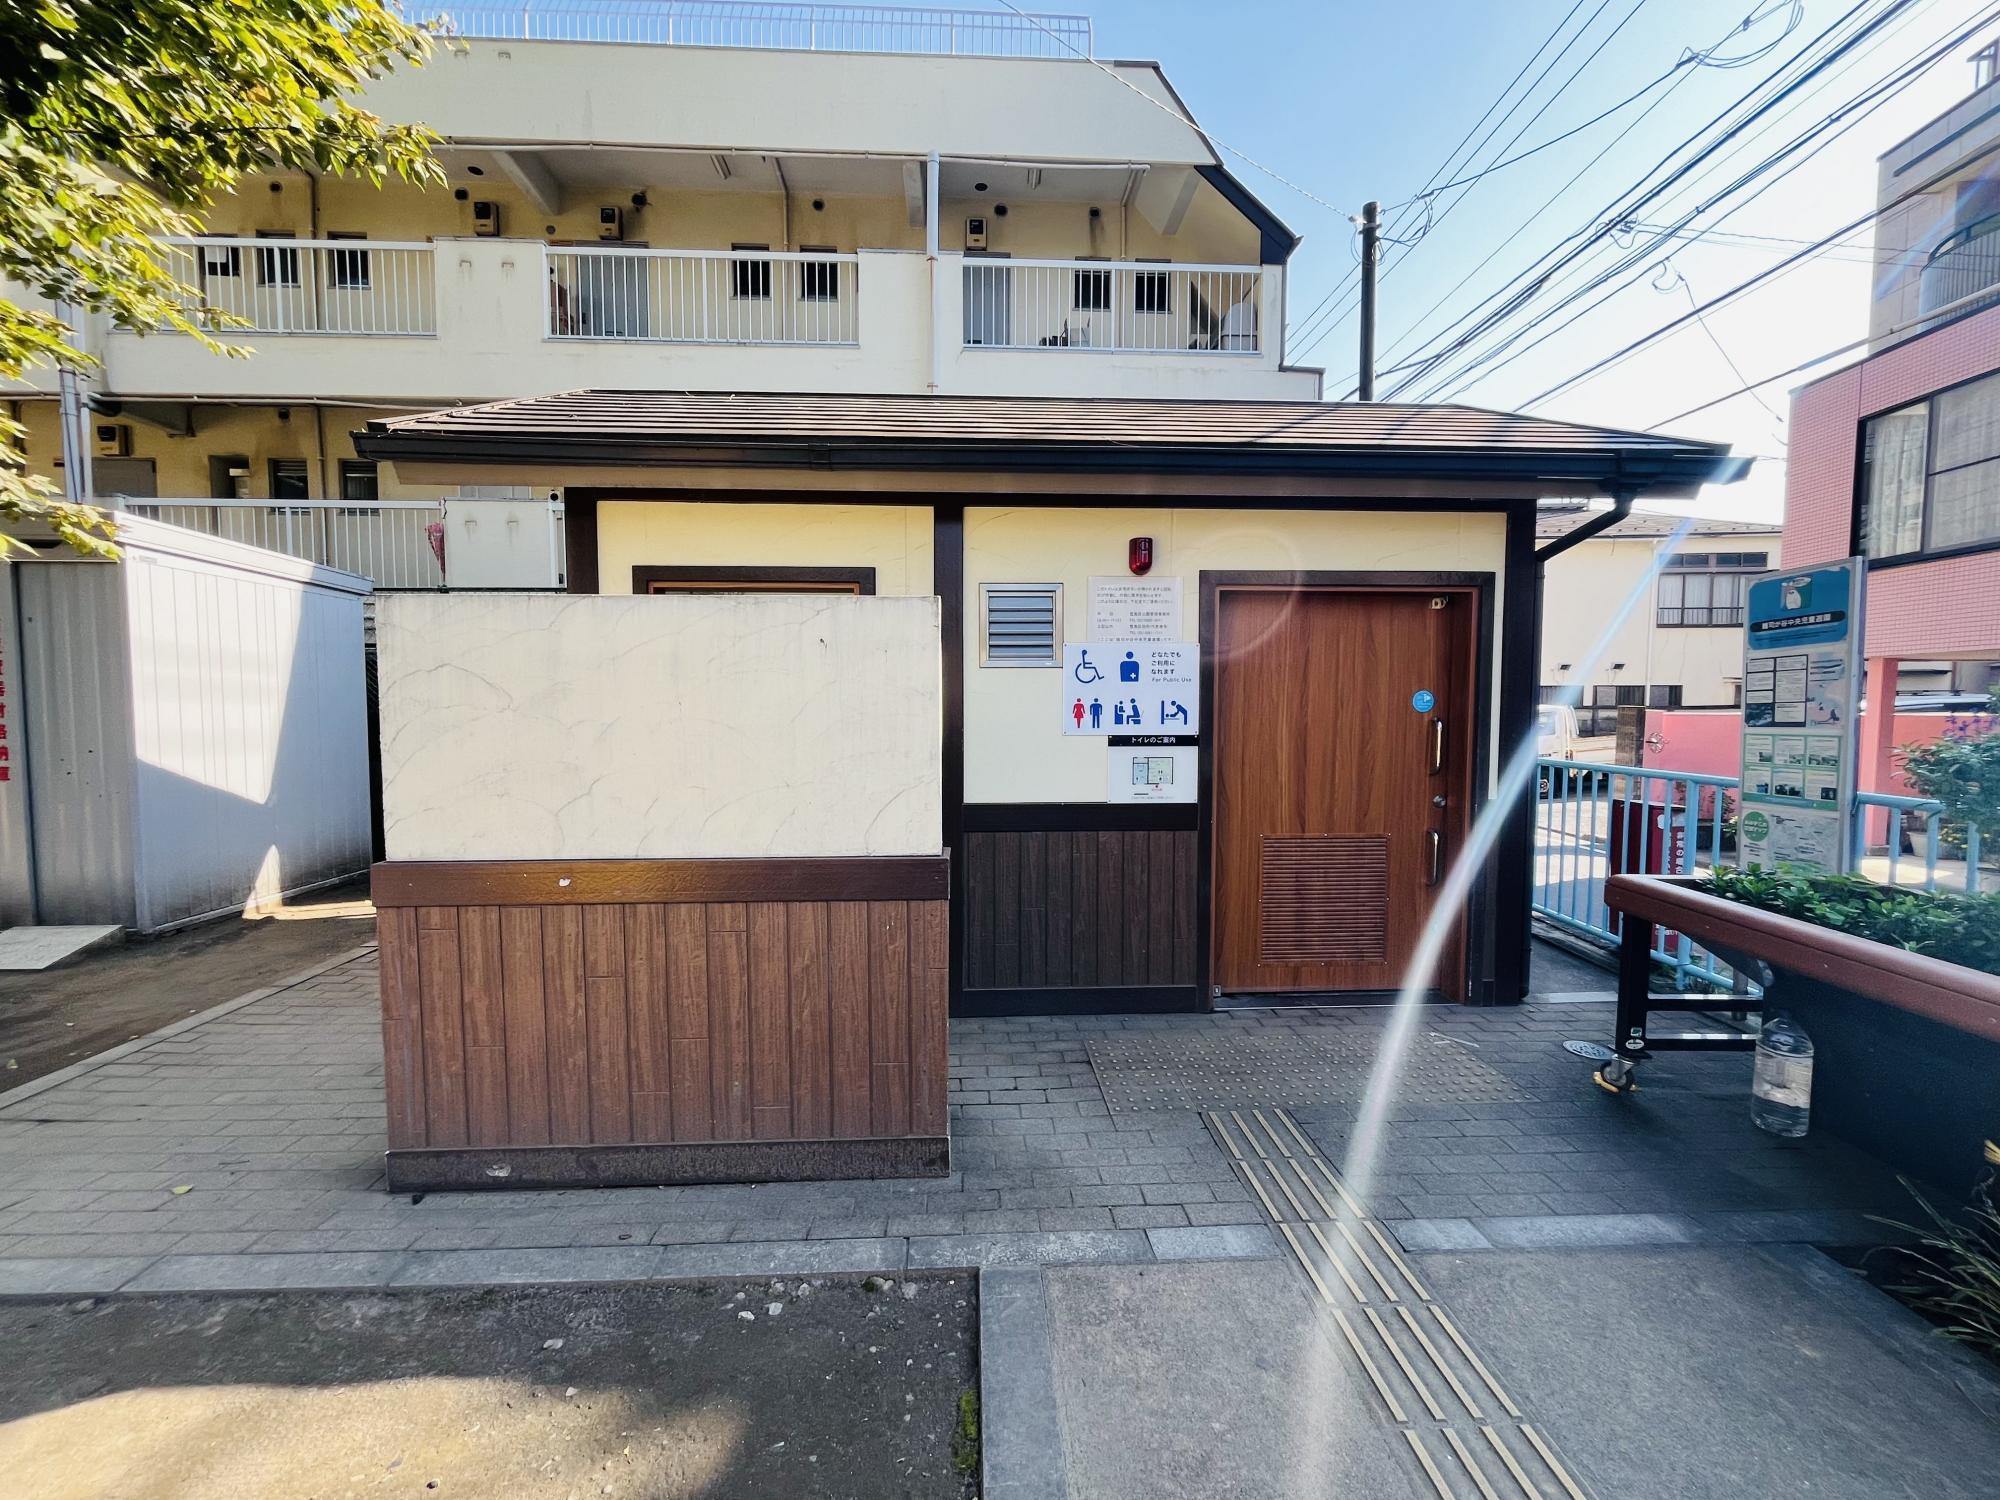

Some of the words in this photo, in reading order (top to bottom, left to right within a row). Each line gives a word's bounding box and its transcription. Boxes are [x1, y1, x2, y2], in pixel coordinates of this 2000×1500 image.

[1131, 736, 1176, 744] トイレのご案内
